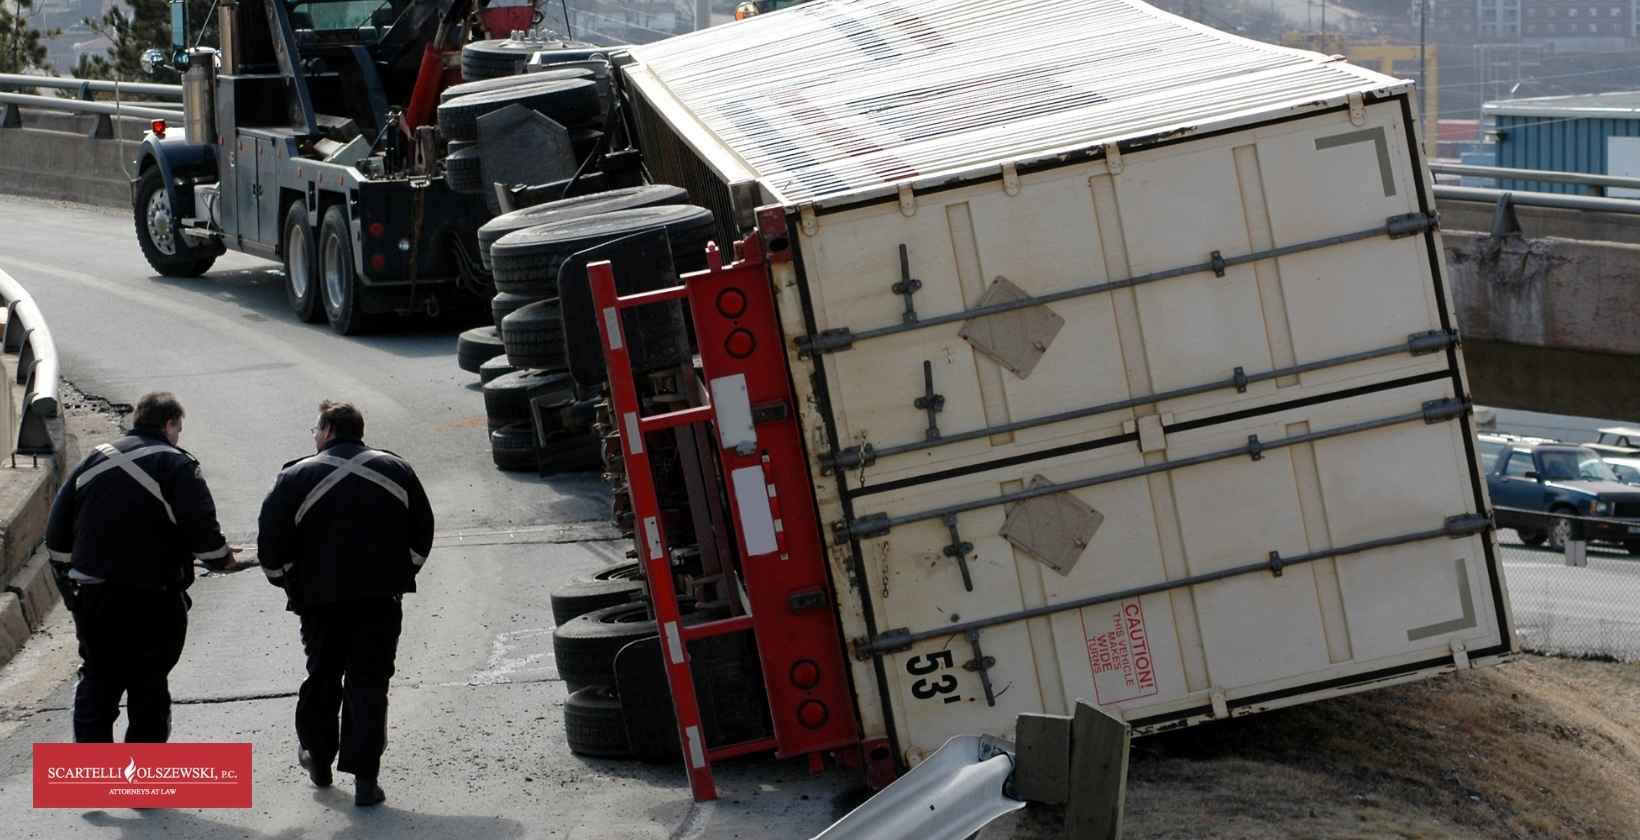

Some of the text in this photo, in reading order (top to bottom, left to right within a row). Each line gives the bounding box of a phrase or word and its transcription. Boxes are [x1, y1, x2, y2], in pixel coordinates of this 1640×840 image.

[1088, 638, 1101, 673] TURNS
[1097, 634, 1112, 672] WIDE
[1108, 632, 1121, 670] MAKES
[1113, 611, 1135, 688] THIS VEHICLE
[1125, 604, 1154, 688] CAUTION!
